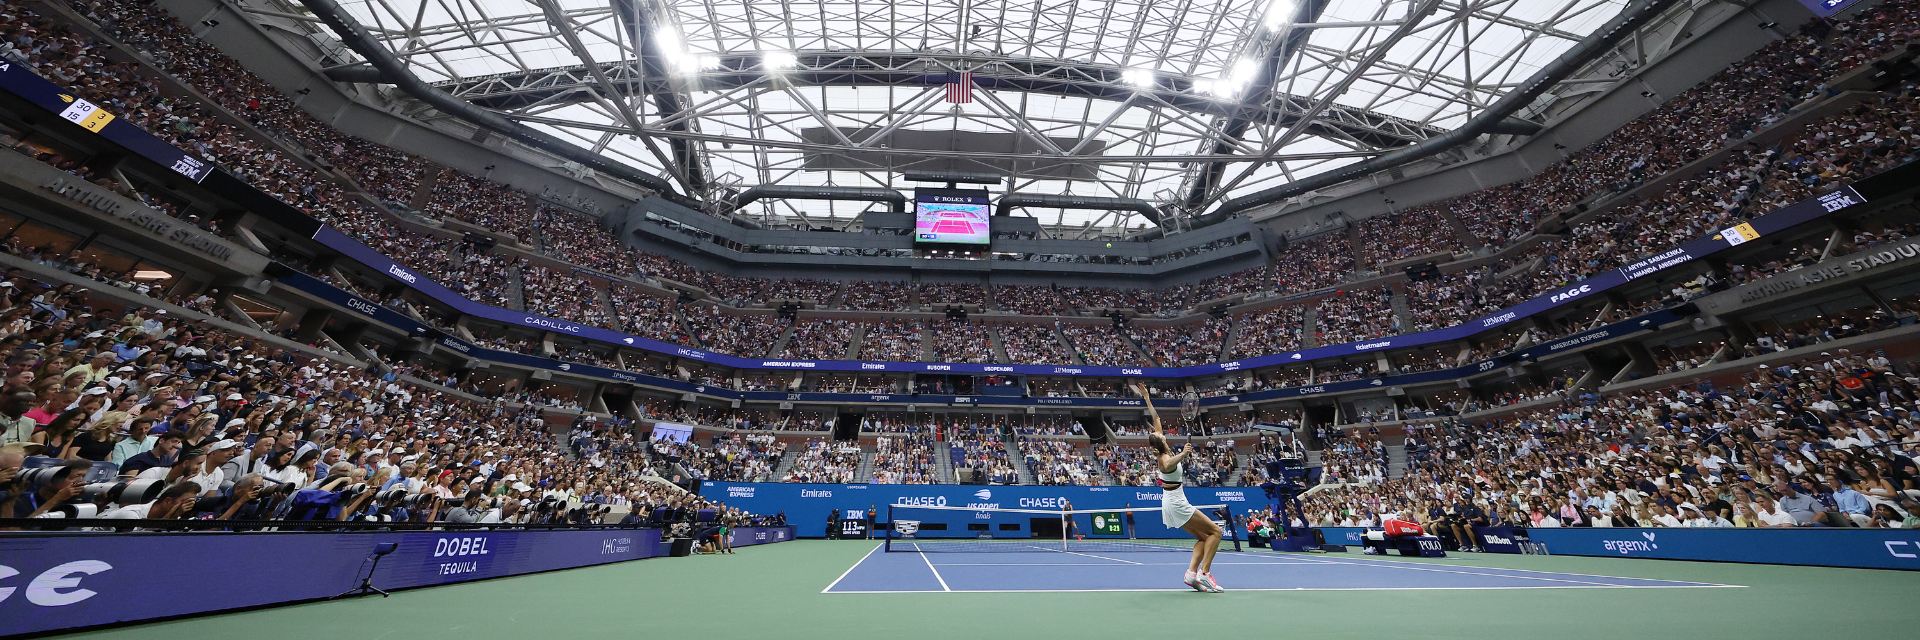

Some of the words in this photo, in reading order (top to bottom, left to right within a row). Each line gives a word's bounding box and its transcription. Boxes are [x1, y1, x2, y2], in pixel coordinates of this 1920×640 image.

[76, 102, 91, 112] 30
[97, 112, 106, 120] 3
[67, 111, 80, 120] 15
[87, 121, 96, 129] 3
[171, 160, 200, 179] IBM
[1821, 195, 1858, 212] IBM
[45, 178, 122, 215] ARTHUR
[121, 209, 172, 236] ASHE
[169, 229, 233, 261] STADIUM
[1628, 260, 1648, 272] ARYNA
[1647, 247, 1685, 265] SABALENKA
[1633, 266, 1658, 279] AMANDA
[1658, 254, 1693, 271] ANISIMOVA
[388, 264, 417, 284] Emirates
[1739, 280, 1799, 304] ARTHUR
[1800, 265, 1846, 287] ASHE
[1550, 284, 1591, 303] FAGE
[347, 298, 378, 316] CHASE
[524, 316, 580, 333] CADILLAC
[444, 338, 471, 353] ticketmaster
[1355, 341, 1391, 350] ticketmaster
[1550, 338, 1580, 351] AMERICAN
[1580, 330, 1610, 343] EXPRESS
[678, 348, 691, 356] IHG
[862, 362, 885, 370] Emirates
[1300, 386, 1325, 394] CHASE
[801, 489, 832, 498] Emirates
[898, 497, 935, 506] CHASE
[1136, 492, 1163, 500] Emirate
[1020, 498, 1056, 508] CHASE
[847, 510, 863, 519] IBM
[842, 522, 857, 531] 113
[434, 537, 489, 557] DOBEL
[601, 538, 617, 555] IHG
[1419, 540, 1442, 550] POLO
[1484, 534, 1512, 545] Wilson
[1604, 534, 1653, 554] argenx
[1885, 541, 1920, 558] C
[439, 561, 477, 575] TEQUILA
